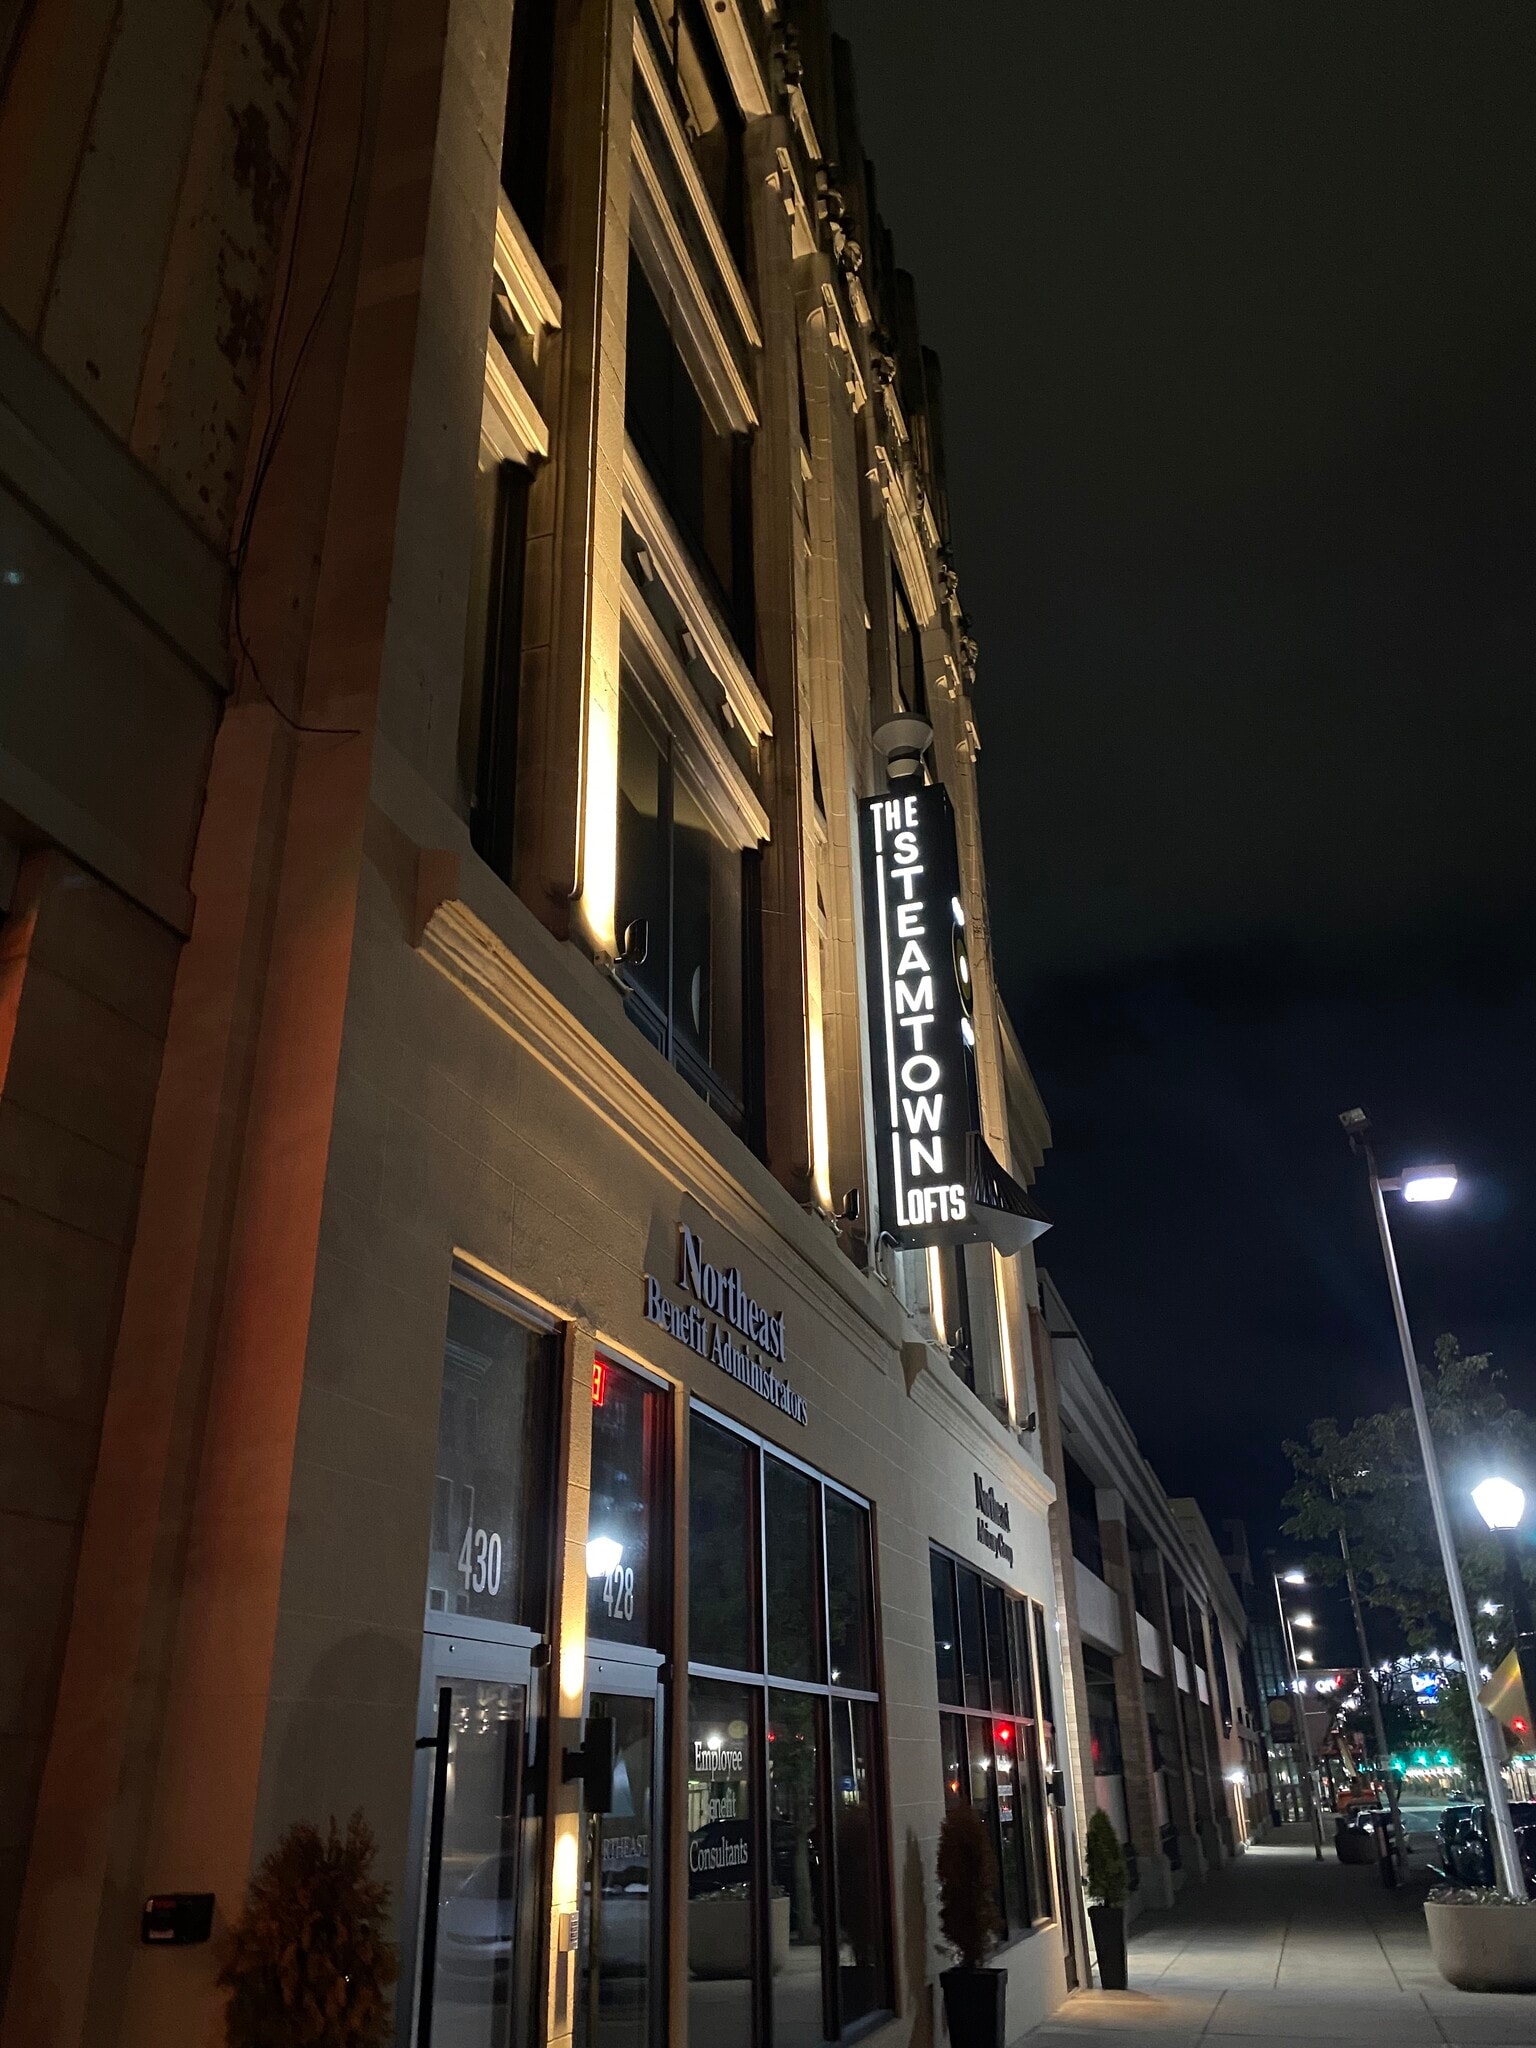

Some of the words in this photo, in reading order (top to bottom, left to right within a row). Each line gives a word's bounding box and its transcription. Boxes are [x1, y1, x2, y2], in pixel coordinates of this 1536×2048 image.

[869, 795, 919, 853] THE
[890, 831, 944, 1176] STEAMTOWN
[892, 1131, 966, 1227] LOFTS
[676, 1222, 786, 1363] Northeast
[644, 1274, 709, 1358] Benefit
[711, 1322, 808, 1426] Administrators
[457, 1526, 502, 1596] 430
[603, 1564, 635, 1621] 428
[694, 1741, 743, 1781] Employee
[689, 1835, 749, 1873] Consultants
